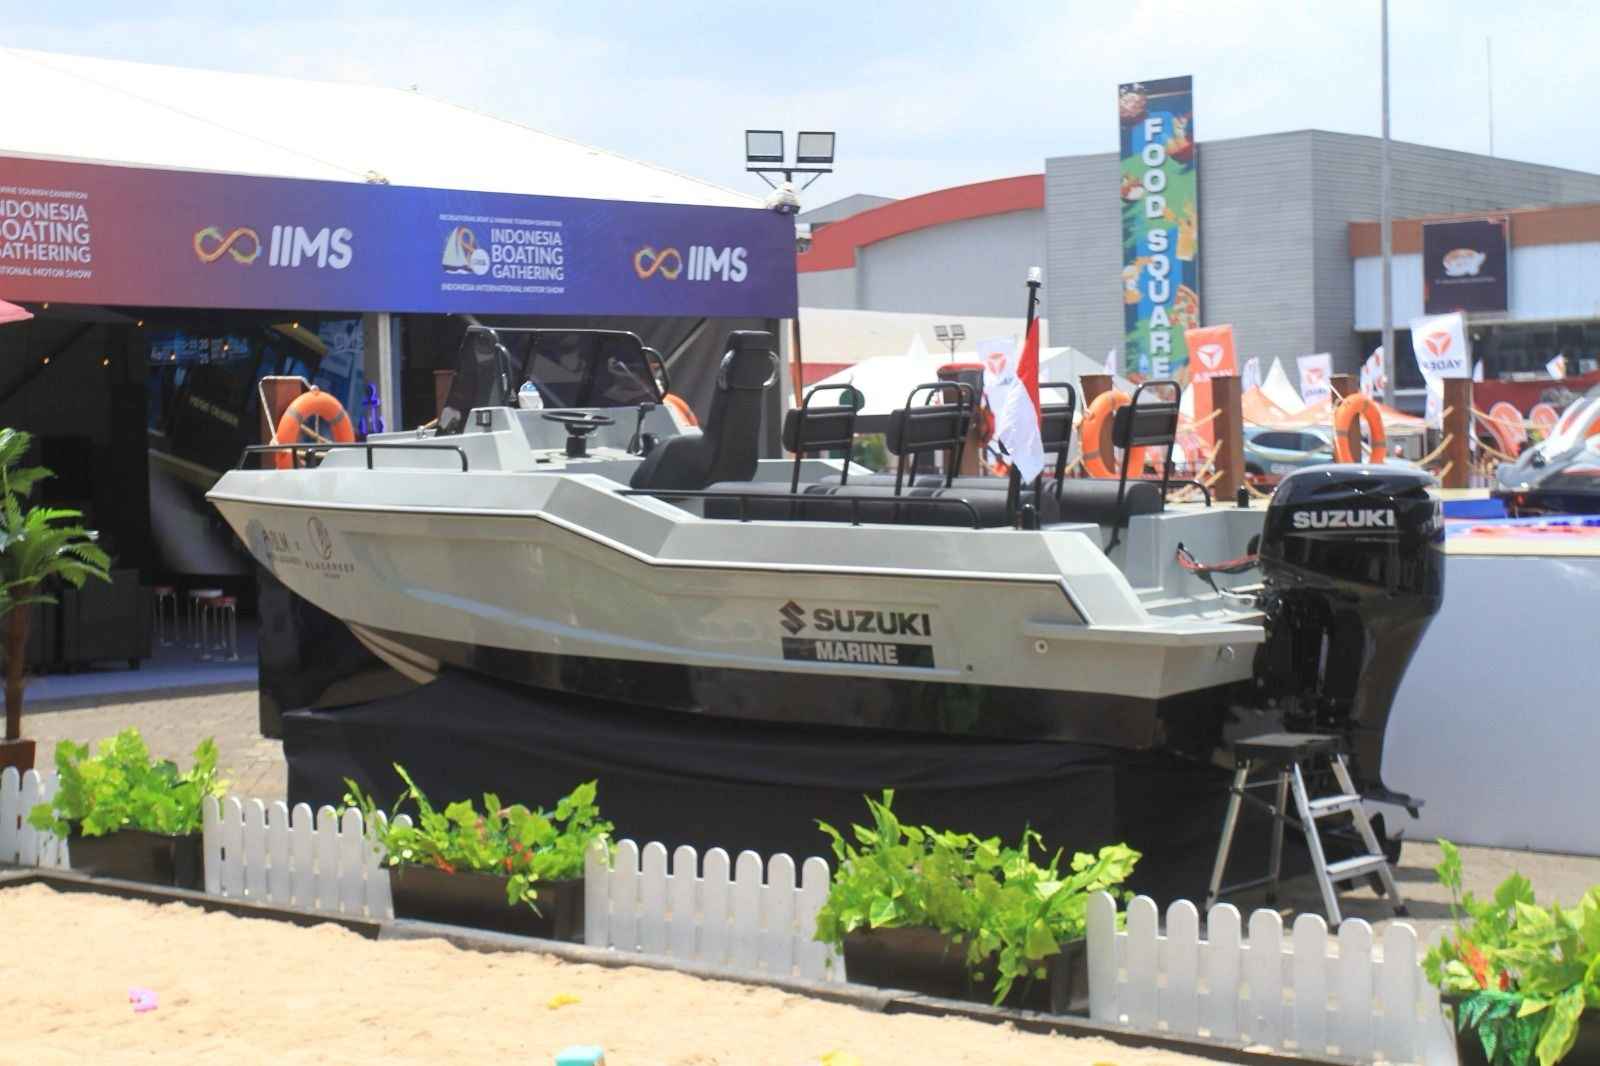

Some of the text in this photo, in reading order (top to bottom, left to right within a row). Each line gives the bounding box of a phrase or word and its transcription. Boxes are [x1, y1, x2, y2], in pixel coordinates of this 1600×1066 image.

[0, 218, 90, 244] OATING
[490, 227, 563, 246] INDONESIA
[0, 242, 92, 263] ATHERING
[268, 224, 354, 270] IIMS
[490, 244, 564, 265] BOATING
[1142, 117, 1173, 380] FOOD SQUARE
[65, 268, 92, 279] SHOW
[491, 263, 564, 281] GATHERING
[686, 244, 749, 283] IIMS
[1293, 509, 1395, 529] SUZUKI
[813, 608, 932, 637] SUZUKI
[815, 640, 899, 665] MARINE
